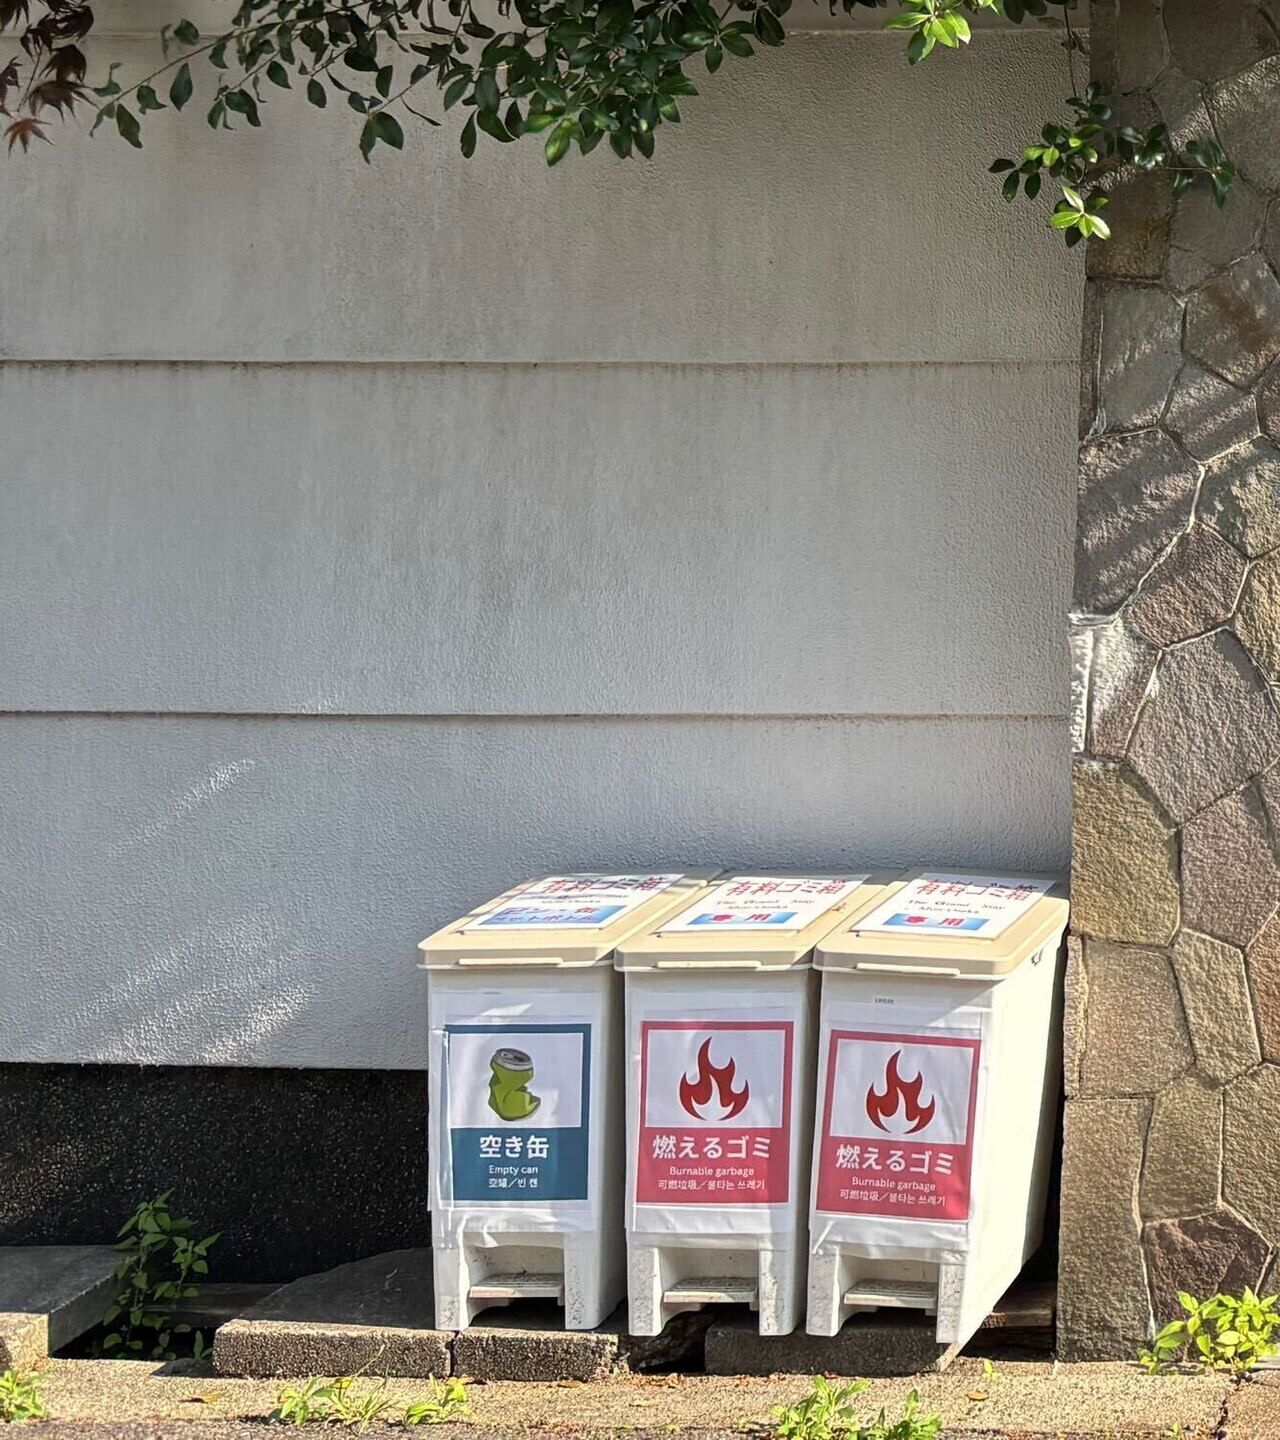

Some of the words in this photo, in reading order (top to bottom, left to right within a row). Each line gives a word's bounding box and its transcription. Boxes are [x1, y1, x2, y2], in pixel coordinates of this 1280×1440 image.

[479, 1135, 549, 1159] 空き缶
[652, 1134, 771, 1159] 燃えるゴミ
[836, 1144, 953, 1175] 燃えるゴミ
[489, 1165, 519, 1176] Empty
[521, 1166, 538, 1174] can
[669, 1166, 713, 1176] Burnable
[715, 1167, 754, 1178] garbage
[852, 1176, 895, 1188] Burnable
[897, 1180, 936, 1192] garbage
